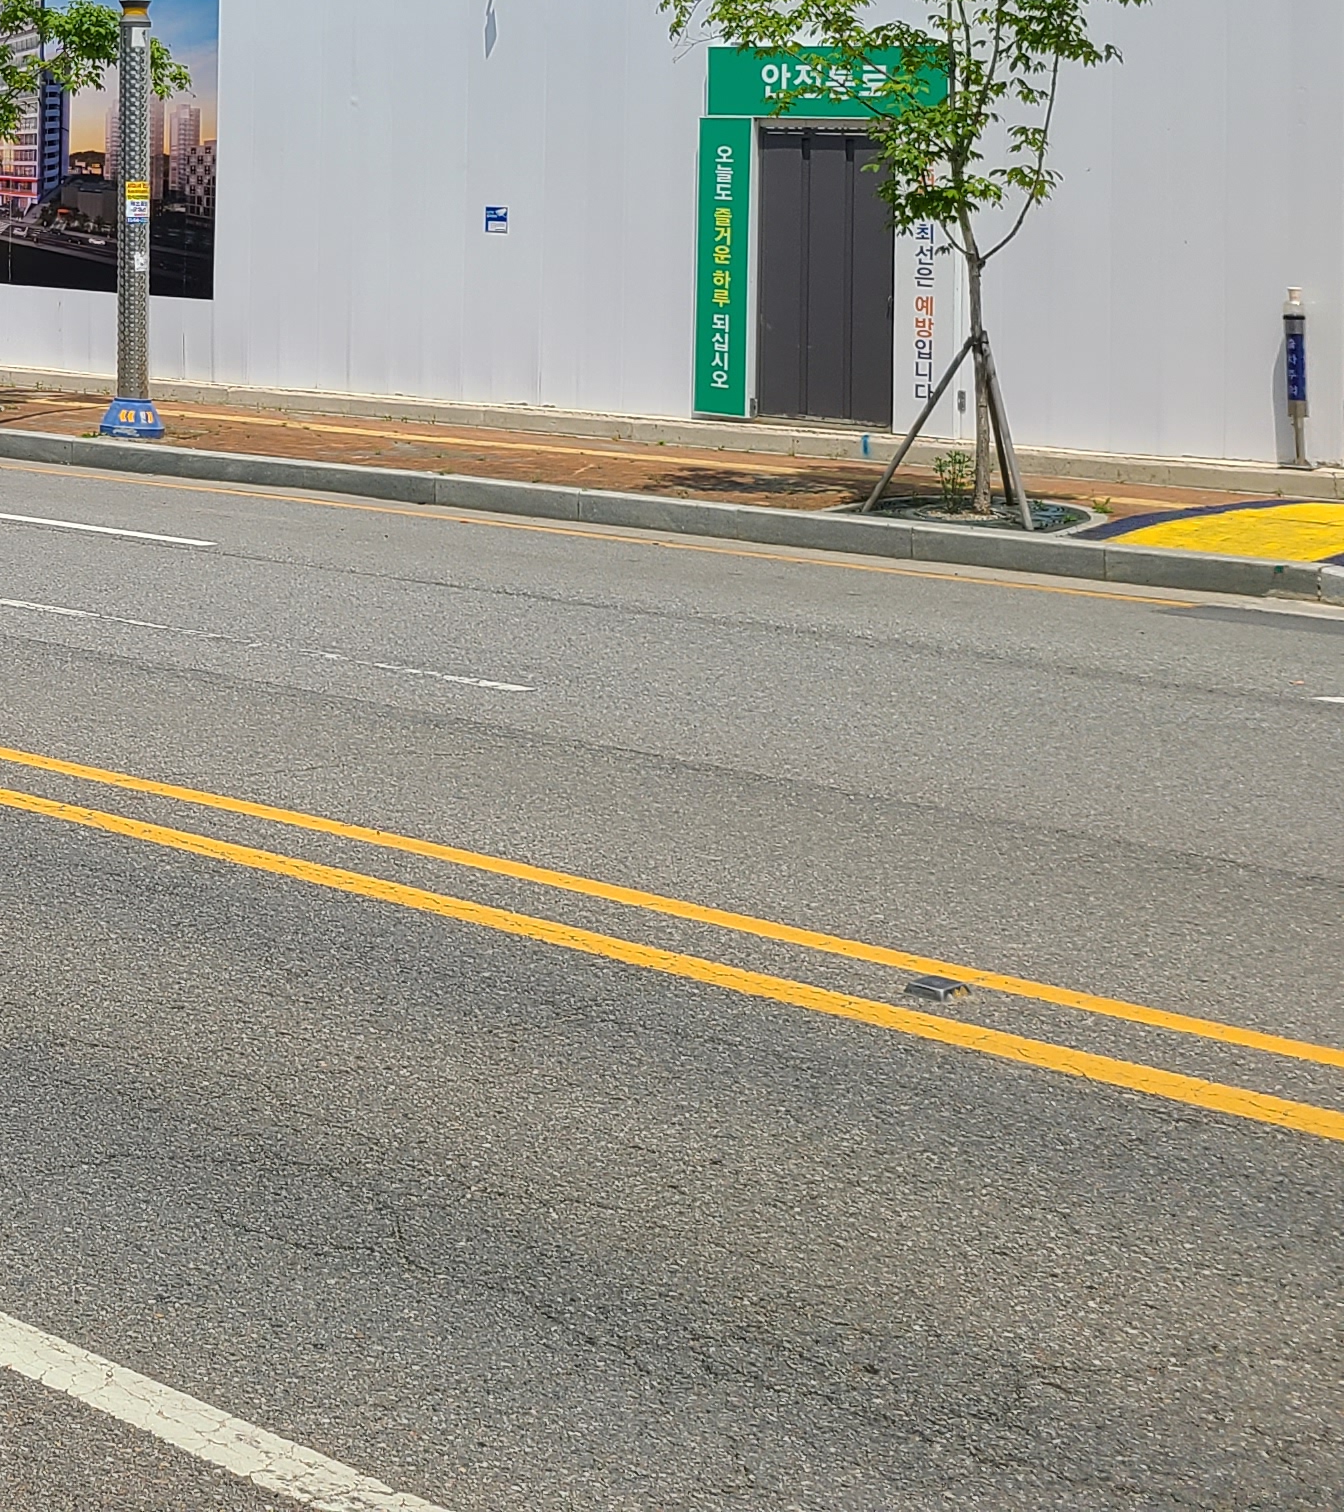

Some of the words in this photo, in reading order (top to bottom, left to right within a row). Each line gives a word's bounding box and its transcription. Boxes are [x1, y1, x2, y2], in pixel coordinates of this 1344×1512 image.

[713, 145, 734, 201] 오늘도
[712, 207, 732, 265] 즐거운
[914, 223, 935, 288] 최선은
[711, 270, 731, 308] 하루
[710, 314, 730, 389] 되십시오
[914, 295, 935, 402] 예방입니다
